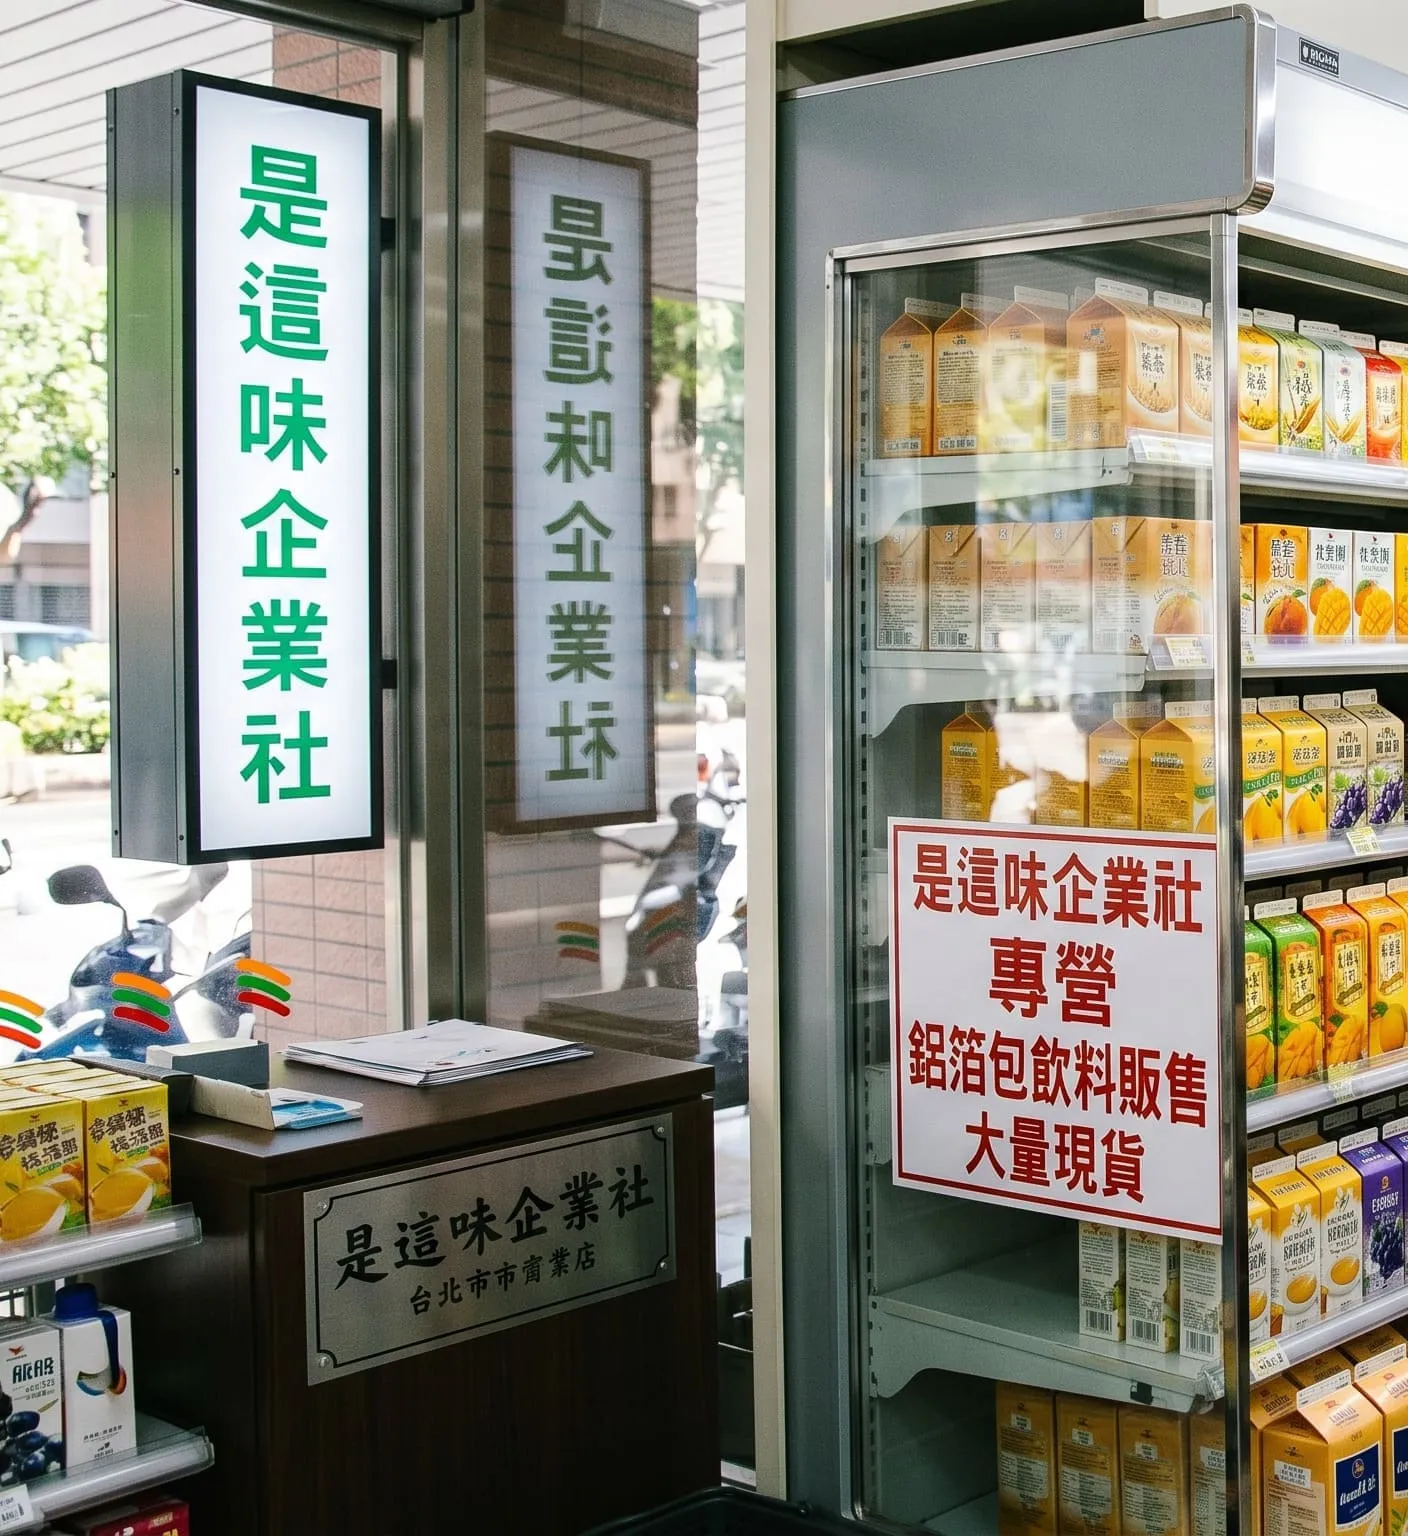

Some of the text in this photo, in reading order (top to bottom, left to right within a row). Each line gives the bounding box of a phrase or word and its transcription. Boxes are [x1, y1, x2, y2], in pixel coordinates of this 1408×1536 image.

[239, 144, 331, 804] 是這味企業社
[912, 843, 1203, 933] 是這味企業社
[988, 936, 1117, 1028] 專營
[907, 1019, 1208, 1128] 鋁箔包飲料販售
[965, 1110, 1145, 1203] 大量現貨
[335, 1164, 655, 1291] 是這味企業社
